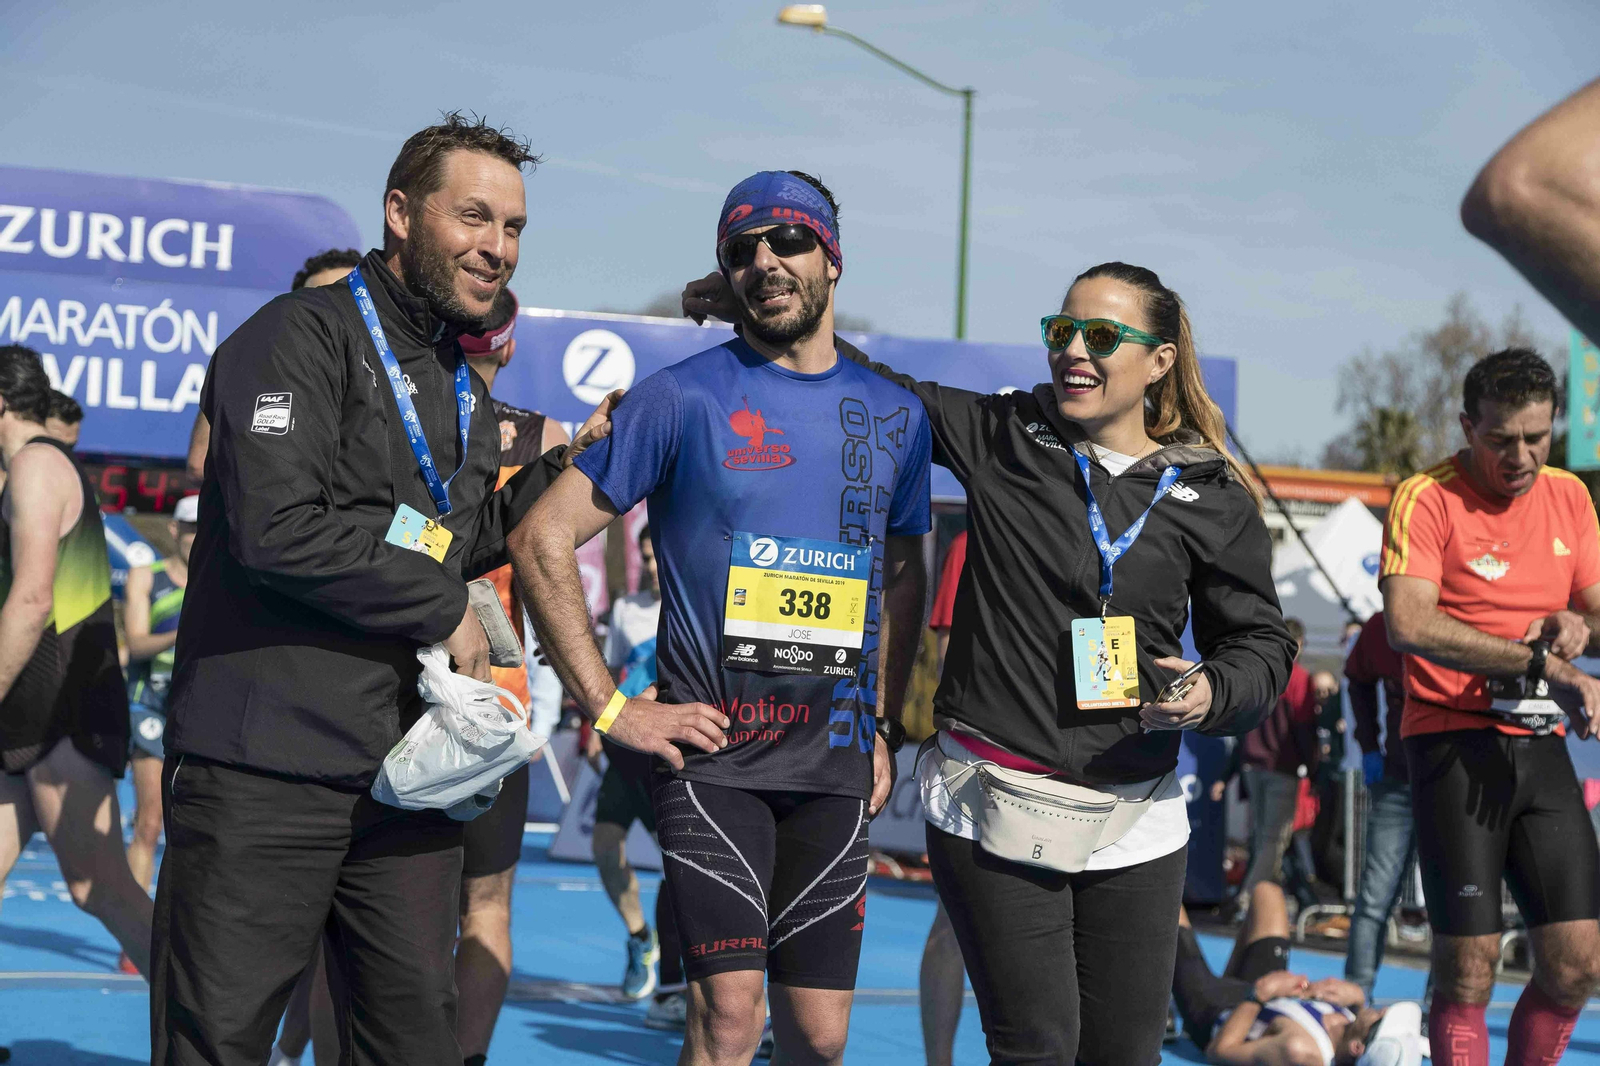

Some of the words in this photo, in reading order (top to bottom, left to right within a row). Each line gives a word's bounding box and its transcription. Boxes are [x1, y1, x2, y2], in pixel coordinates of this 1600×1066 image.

[0, 205, 234, 271] ZURICH
[0, 295, 218, 355] MARATÓN
[42, 353, 207, 413] VILLA
[727, 443, 791, 457] universo
[733, 453, 781, 465] sevilla
[783, 547, 855, 571] ZURICH
[779, 588, 832, 620] 338
[788, 629, 812, 640] JOSE
[823, 665, 854, 676] ZURICH
[710, 695, 810, 724] Motion
[727, 726, 785, 748] unning
